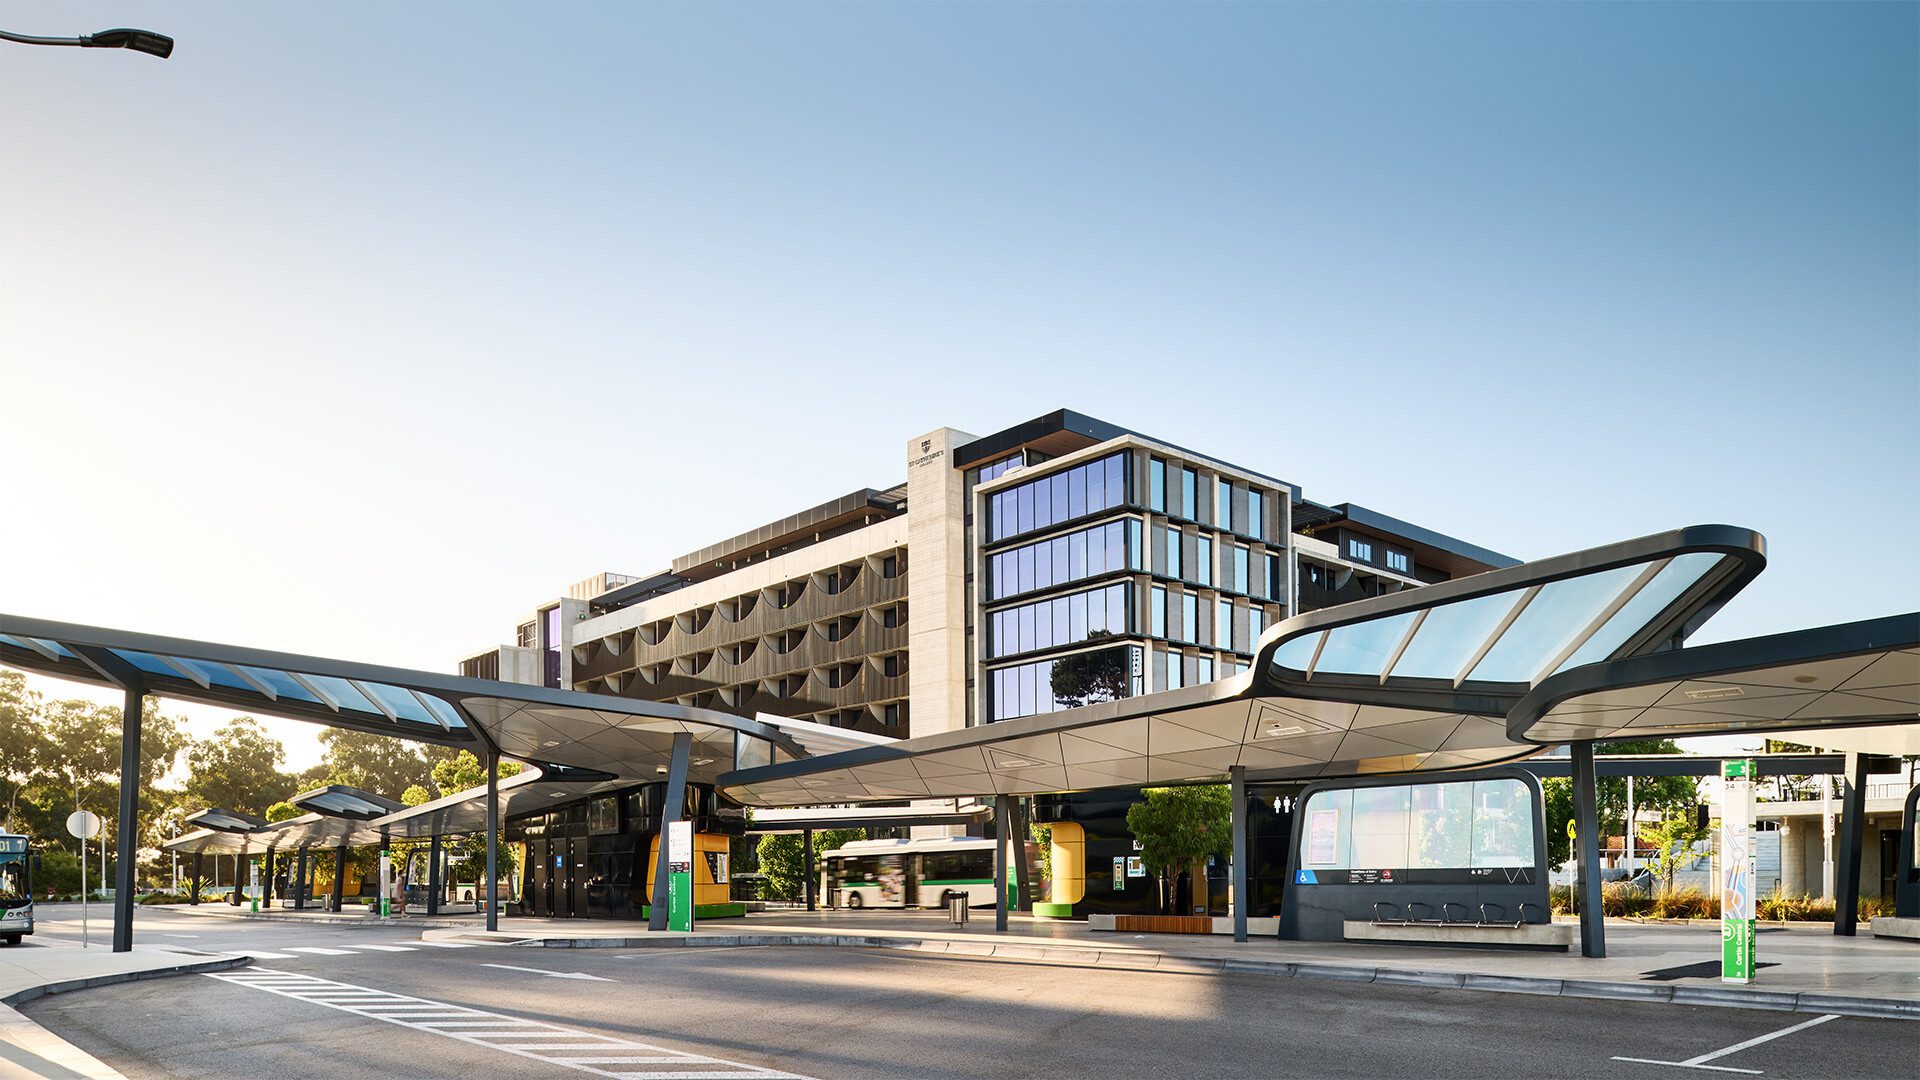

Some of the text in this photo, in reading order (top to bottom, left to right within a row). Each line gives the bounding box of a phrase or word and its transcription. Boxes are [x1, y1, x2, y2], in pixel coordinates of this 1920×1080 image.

[1739, 765, 1746, 774] 3
[1735, 923, 1743, 966] Curtin Central
